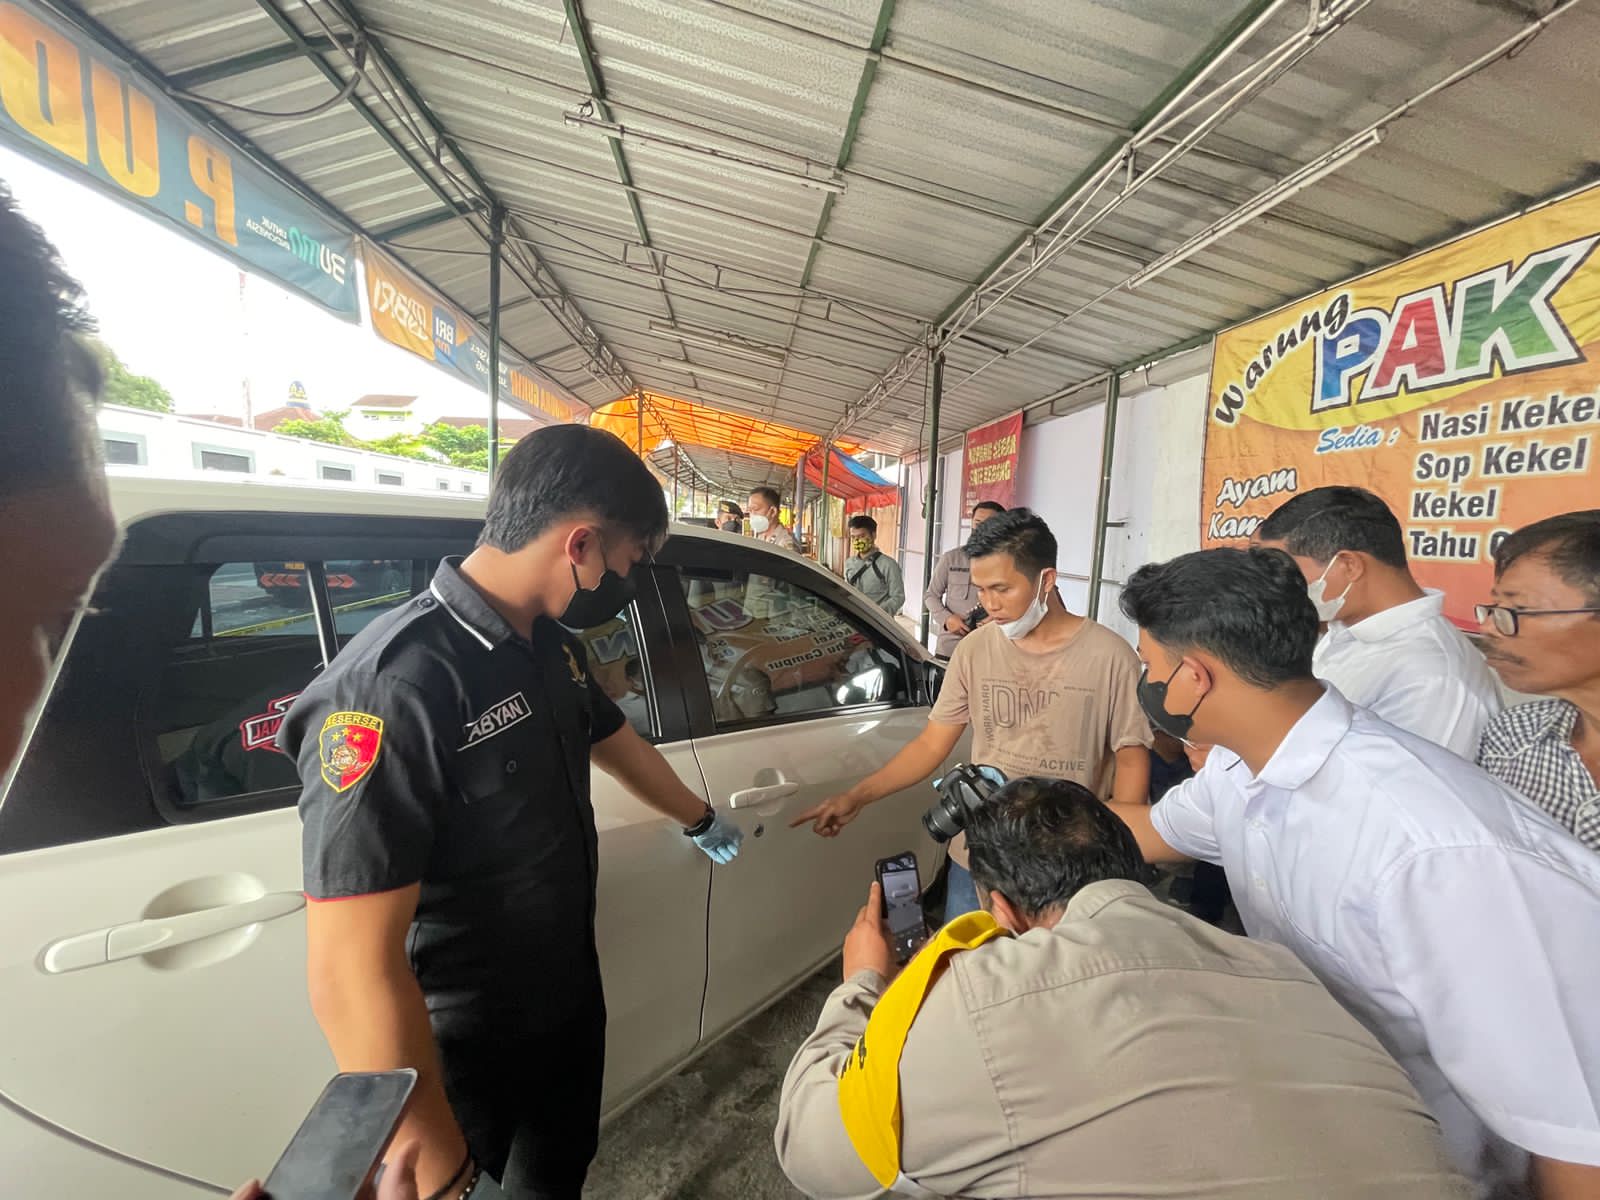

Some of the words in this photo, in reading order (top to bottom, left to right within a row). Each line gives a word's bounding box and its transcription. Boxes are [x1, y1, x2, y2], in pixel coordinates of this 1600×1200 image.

[1311, 232, 1600, 414] PAK
[1215, 293, 1350, 424] Warung
[1421, 405, 1489, 441] Nasi
[1500, 394, 1600, 431] Keke
[1316, 428, 1382, 453] Sedia
[1416, 452, 1471, 484] Sop
[1483, 437, 1588, 475] Kekel
[1216, 467, 1298, 508] Ayam
[1412, 488, 1497, 518] Kekel
[1409, 530, 1477, 558] Tahu
[468, 699, 524, 742] ABYAN
[1039, 758, 1086, 772] ACTIVE
